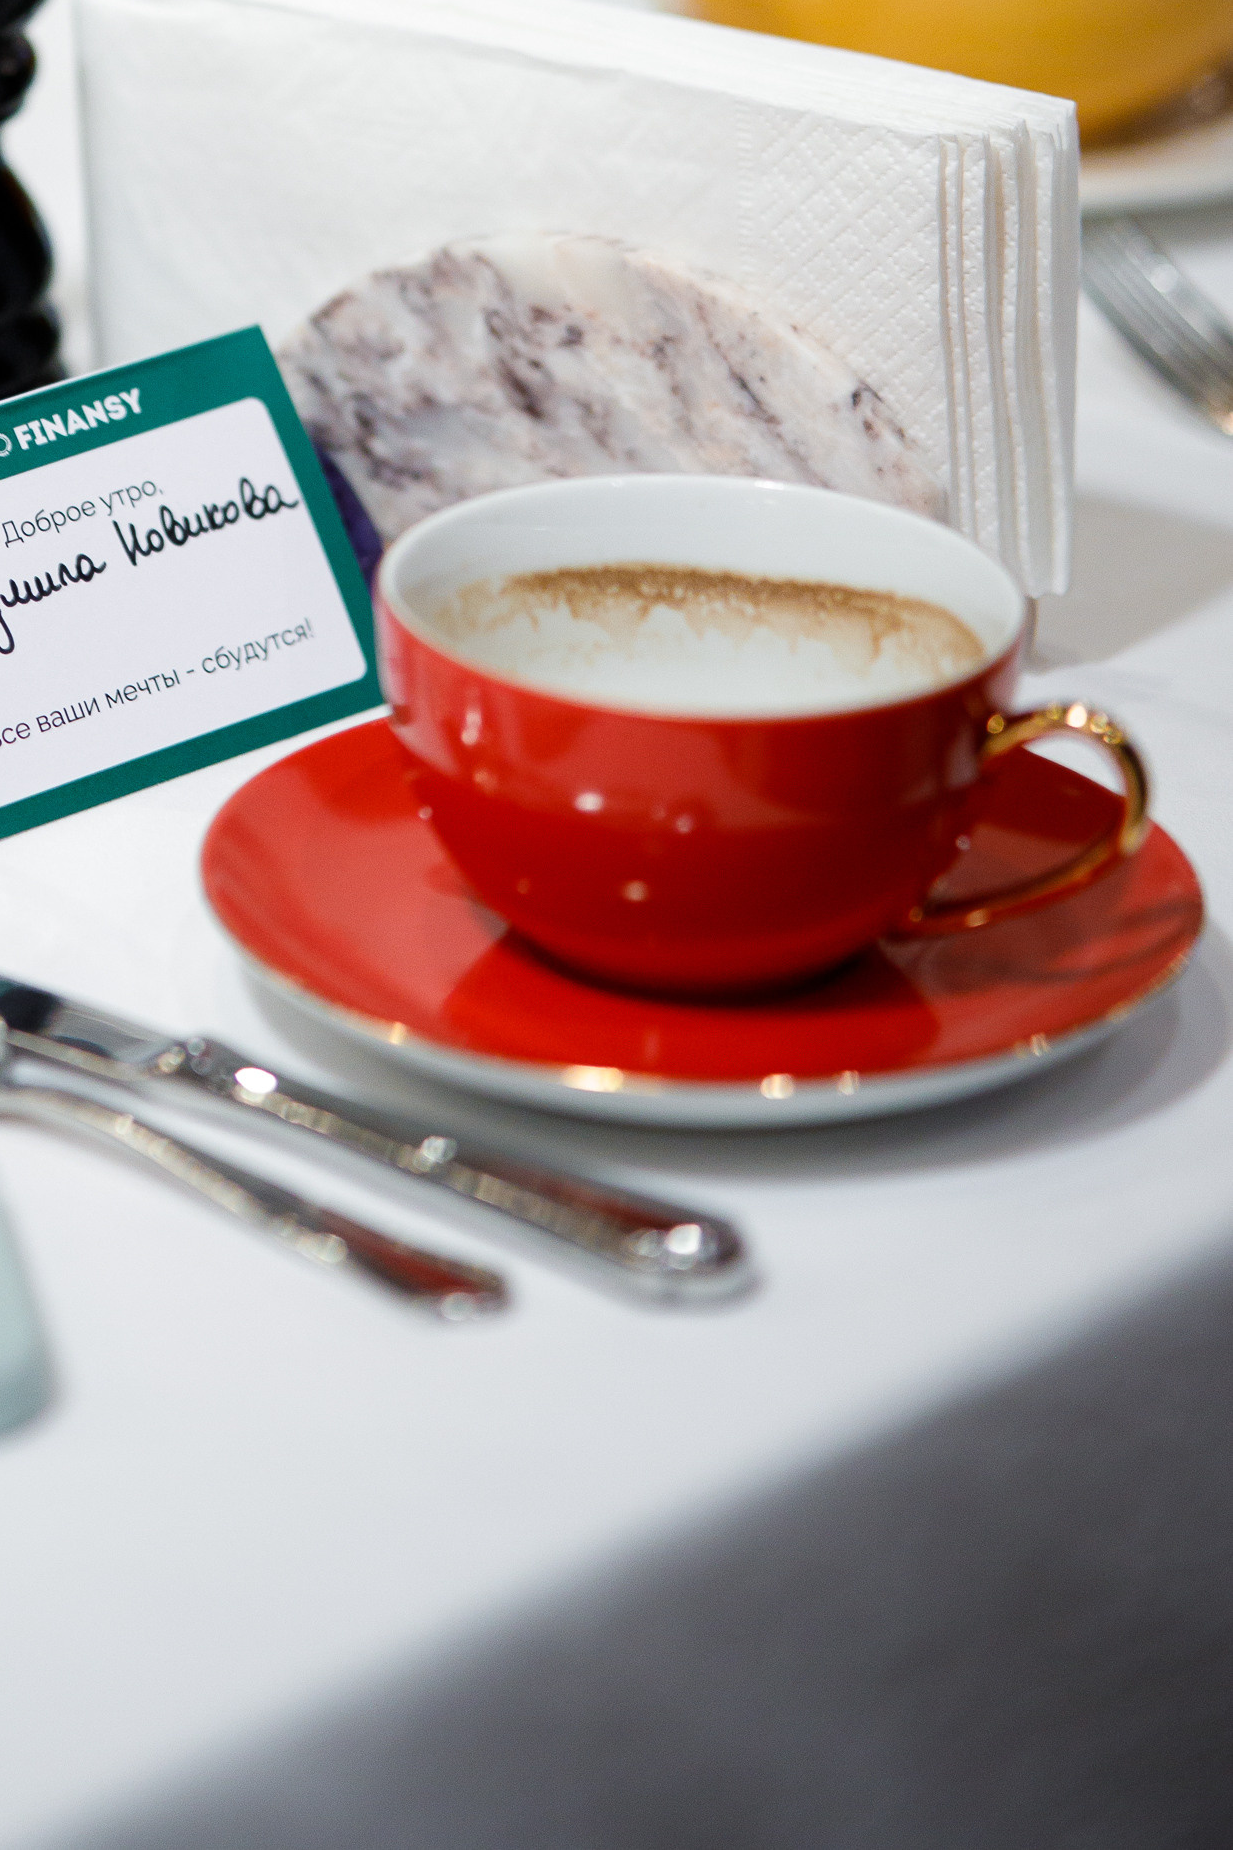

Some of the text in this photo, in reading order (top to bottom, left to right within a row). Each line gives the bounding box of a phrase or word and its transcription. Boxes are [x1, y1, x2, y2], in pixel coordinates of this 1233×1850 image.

[13, 387, 142, 450] FINANSY
[1, 480, 164, 548] Доброе утро,
[35, 697, 101, 733] ваши
[104, 669, 181, 709] мечты
[201, 617, 315, 673] сбудутся!
